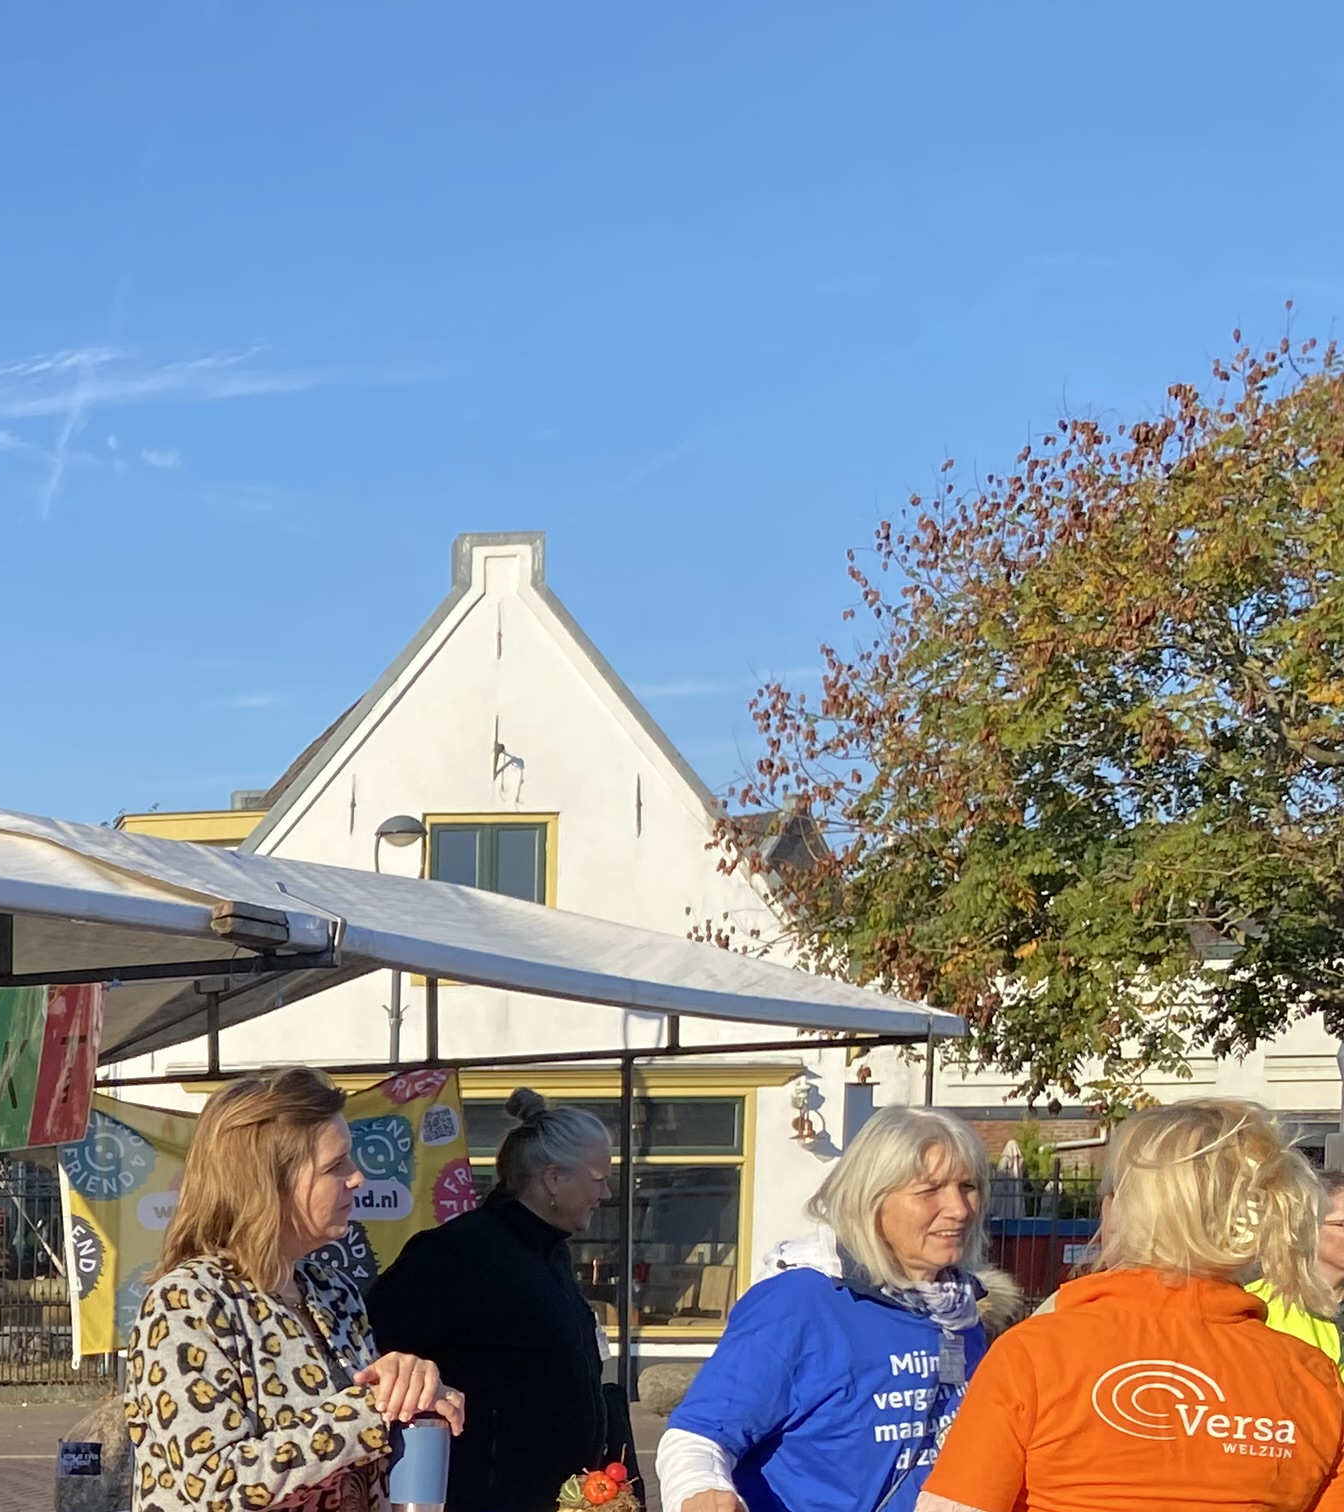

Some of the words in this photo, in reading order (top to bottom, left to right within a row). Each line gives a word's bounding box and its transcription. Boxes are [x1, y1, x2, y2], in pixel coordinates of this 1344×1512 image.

[62, 1148, 134, 1194] FRIEND
[889, 1350, 940, 1378] Mijn
[1175, 1403, 1296, 1444] Versa
[1222, 1443, 1293, 1459] WELZIJN
